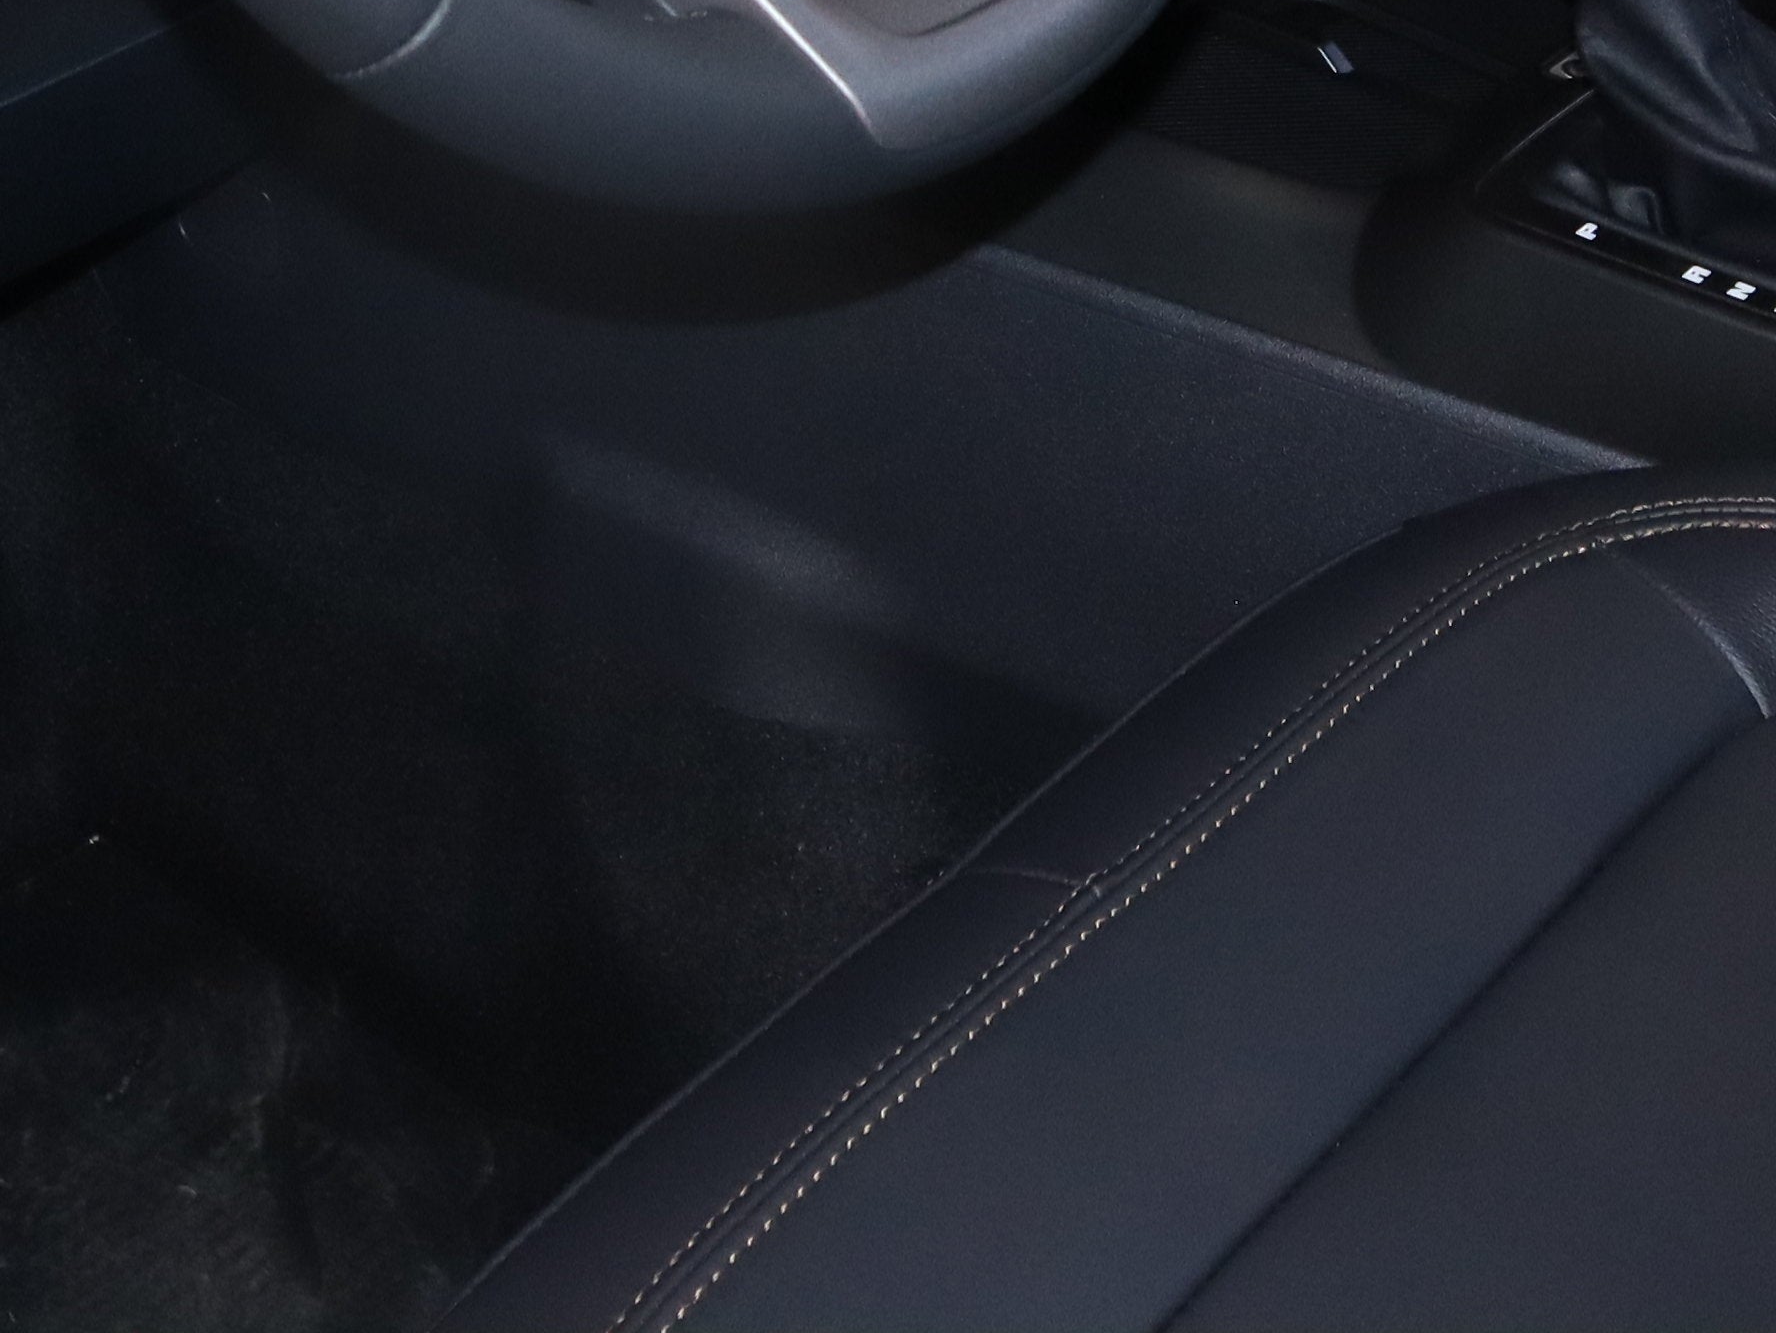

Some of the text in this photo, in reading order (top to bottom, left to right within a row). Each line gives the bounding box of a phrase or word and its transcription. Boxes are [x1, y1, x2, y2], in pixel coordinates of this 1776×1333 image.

[1575, 222, 1598, 241] P
[1681, 265, 1712, 284] R
[1726, 281, 1757, 301] N
